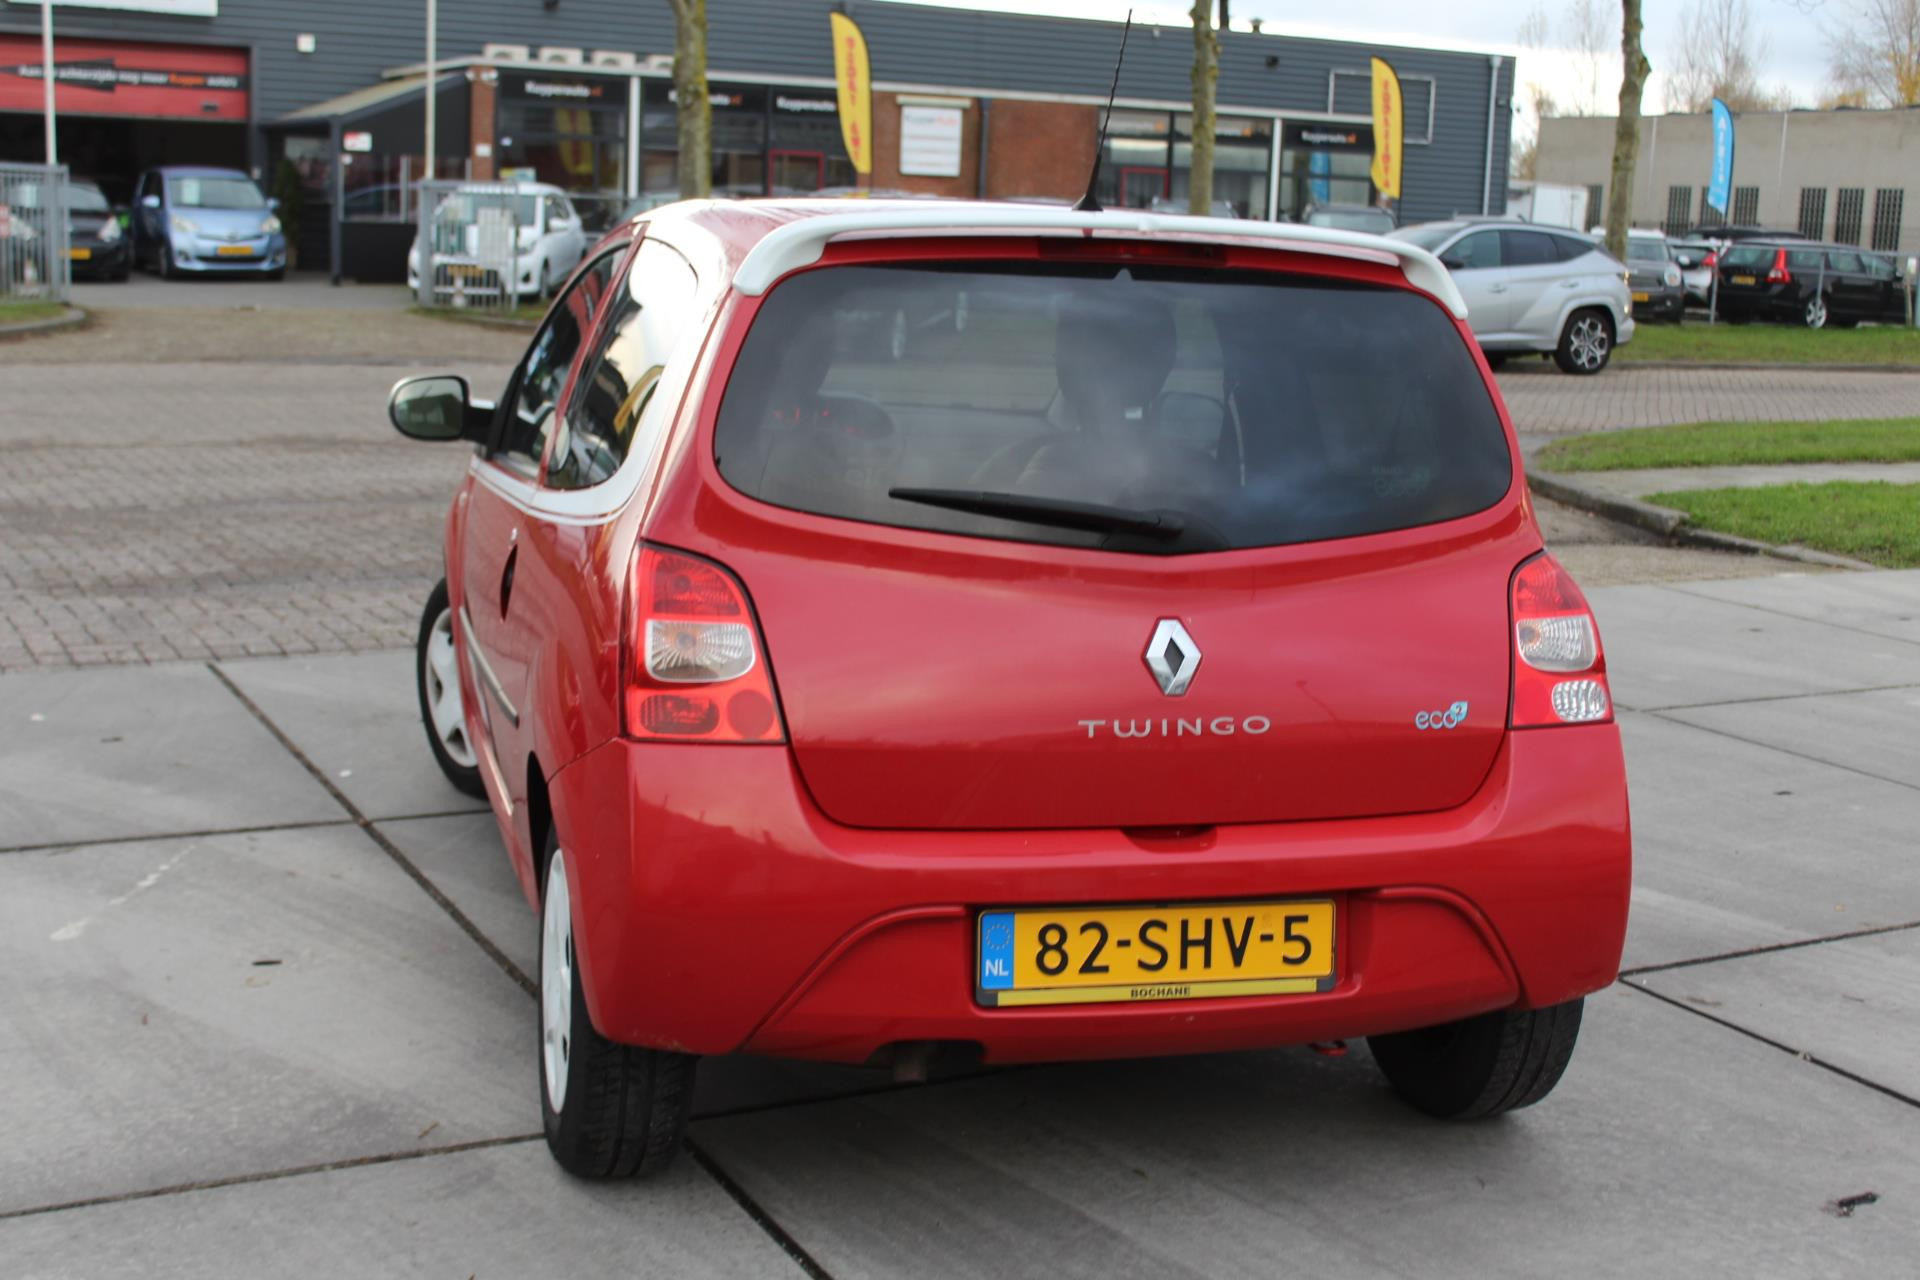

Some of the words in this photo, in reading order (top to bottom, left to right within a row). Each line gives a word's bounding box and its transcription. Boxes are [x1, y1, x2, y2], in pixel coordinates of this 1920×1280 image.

[1078, 715, 1272, 738] TWINGO
[1035, 914, 1313, 976] 82-SHV-5
[985, 959, 1009, 977] NL
[1130, 986, 1191, 999] BOCHANE
